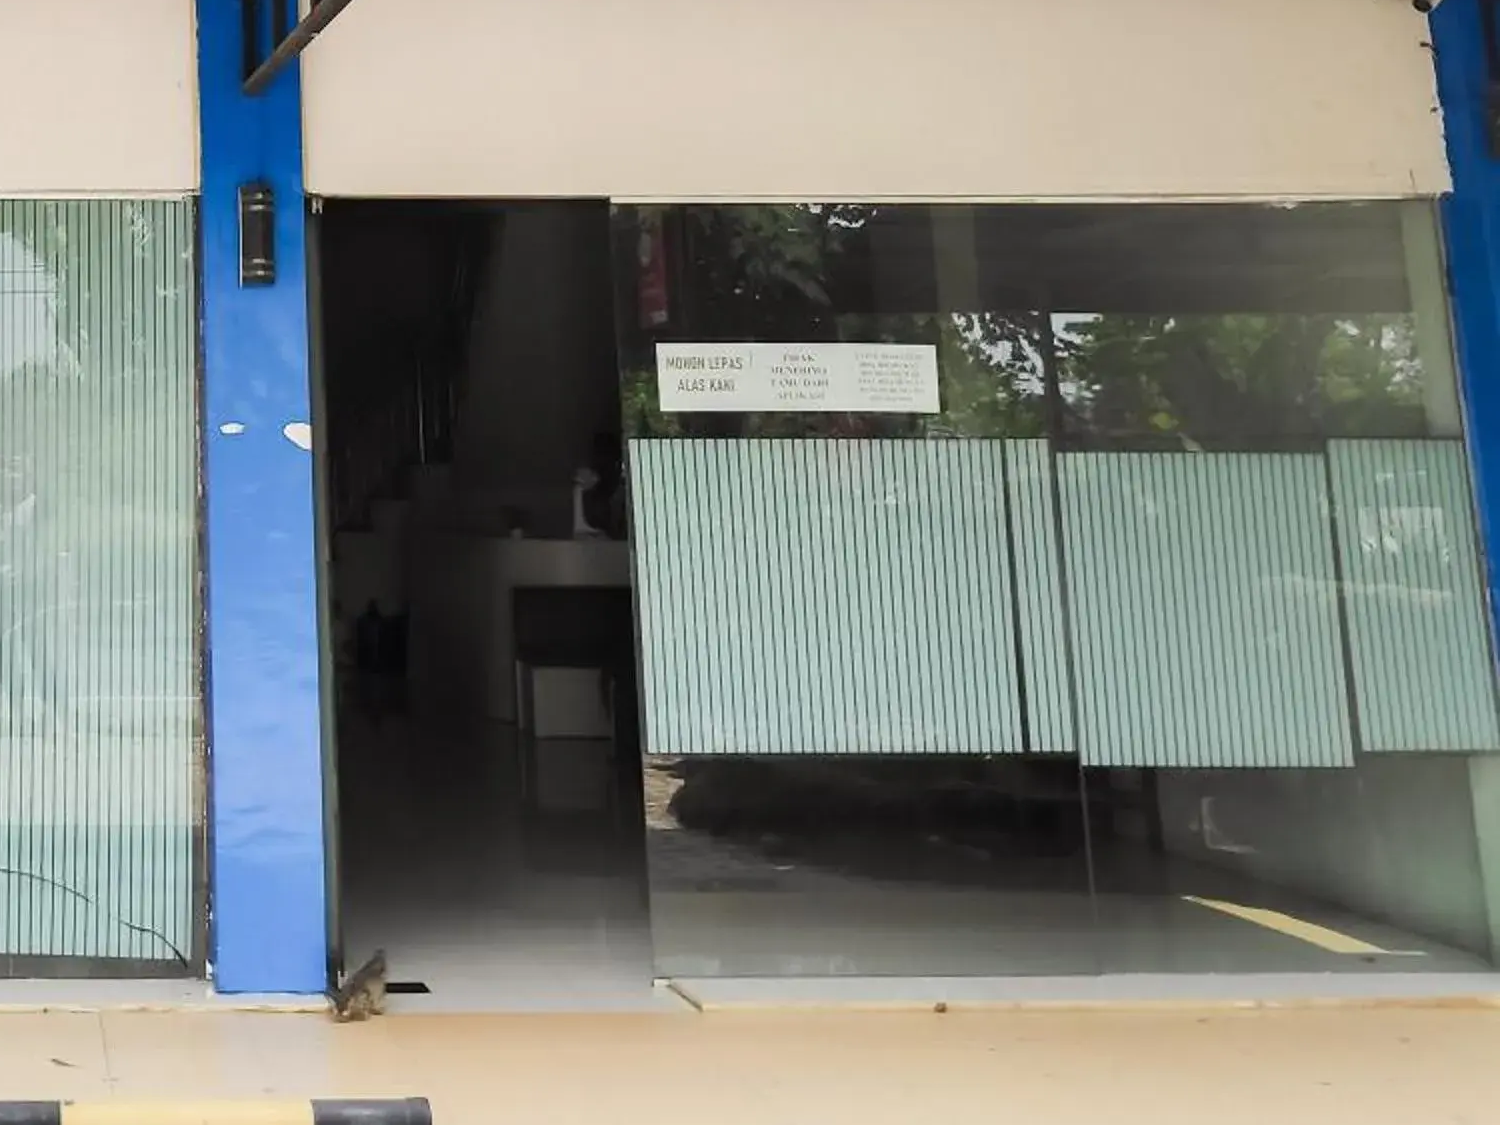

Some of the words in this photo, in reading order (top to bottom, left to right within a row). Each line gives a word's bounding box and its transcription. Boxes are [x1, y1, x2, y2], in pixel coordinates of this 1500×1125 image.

[665, 356, 705, 370] MOHON
[708, 356, 744, 370] LEPAS
[677, 378, 705, 392] ALAS
